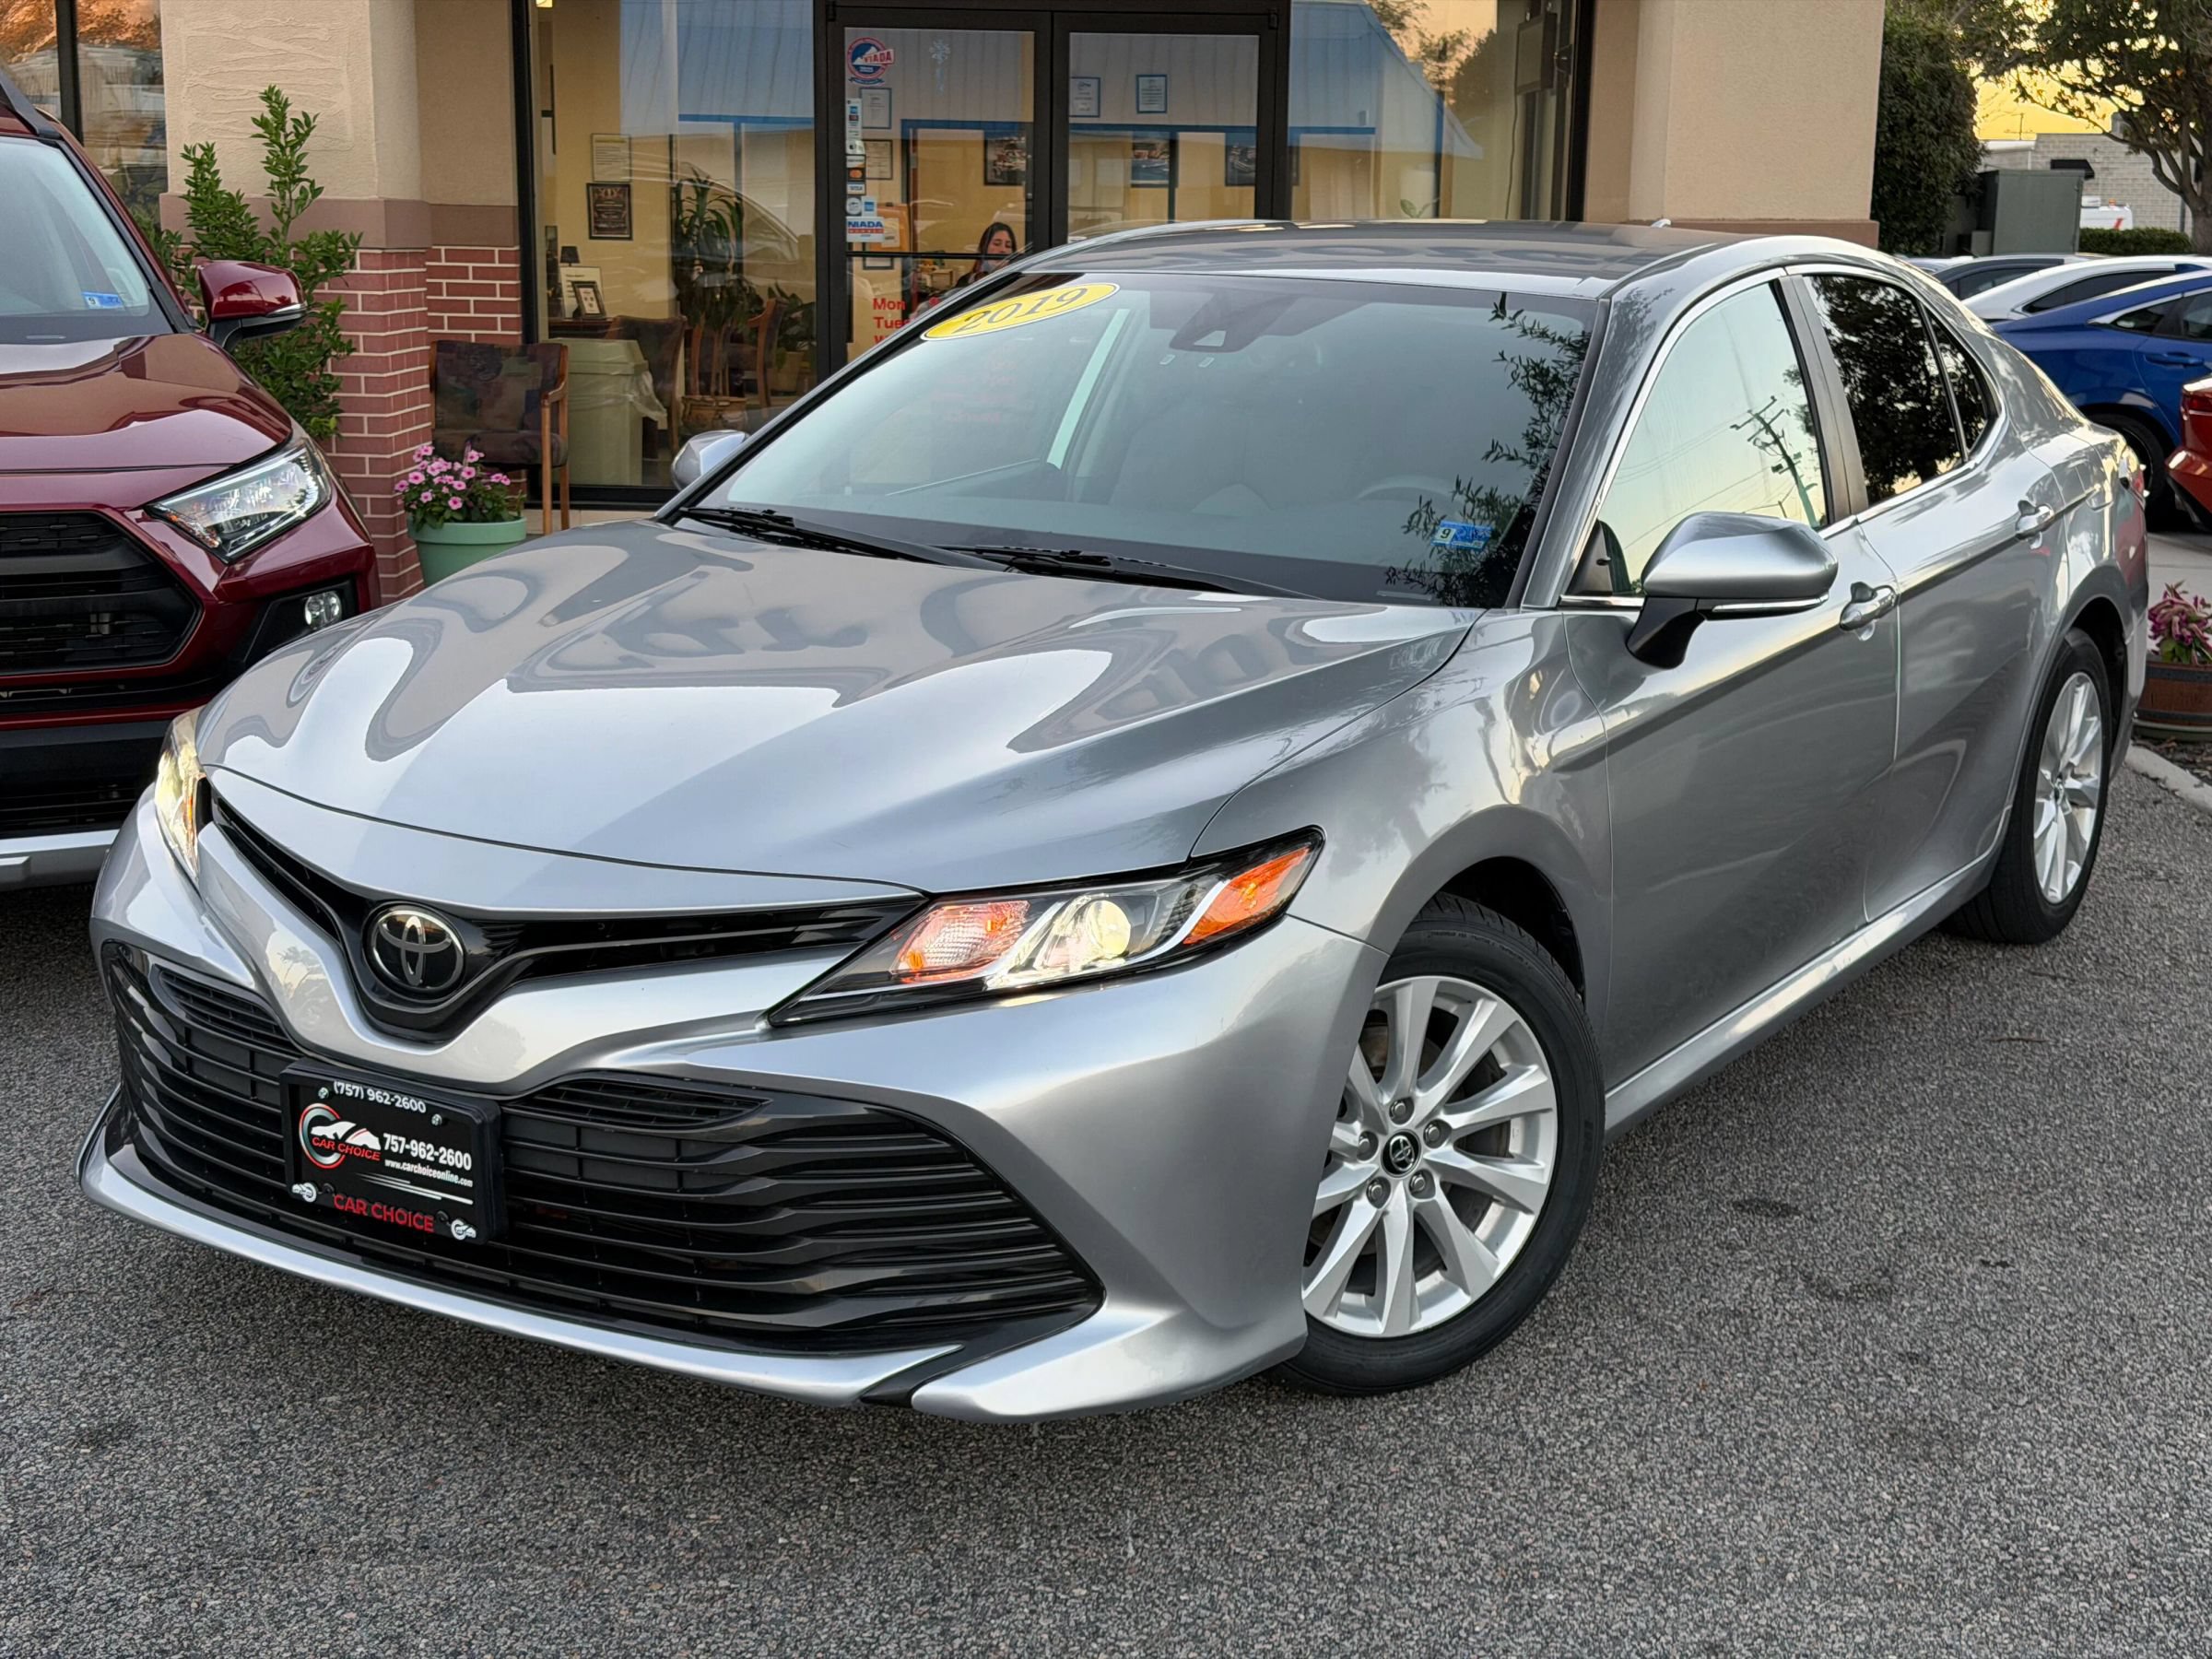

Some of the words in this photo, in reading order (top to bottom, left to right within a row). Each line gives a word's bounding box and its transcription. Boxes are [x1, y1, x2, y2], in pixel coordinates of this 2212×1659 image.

[872, 298, 907, 311] Mon
[951, 288, 1088, 335] 2019
[1440, 528, 1452, 539] 9
[333, 1080, 365, 1100] (757)
[366, 1088, 427, 1113] 962-2600
[312, 1136, 336, 1151] CAR
[337, 1143, 382, 1161] CHOICE
[382, 1132, 473, 1171] 757-962-2600
[384, 1159, 474, 1188] www.carchoiceonline.com
[333, 1193, 369, 1217] CAR
[371, 1202, 436, 1234] CHOICE
